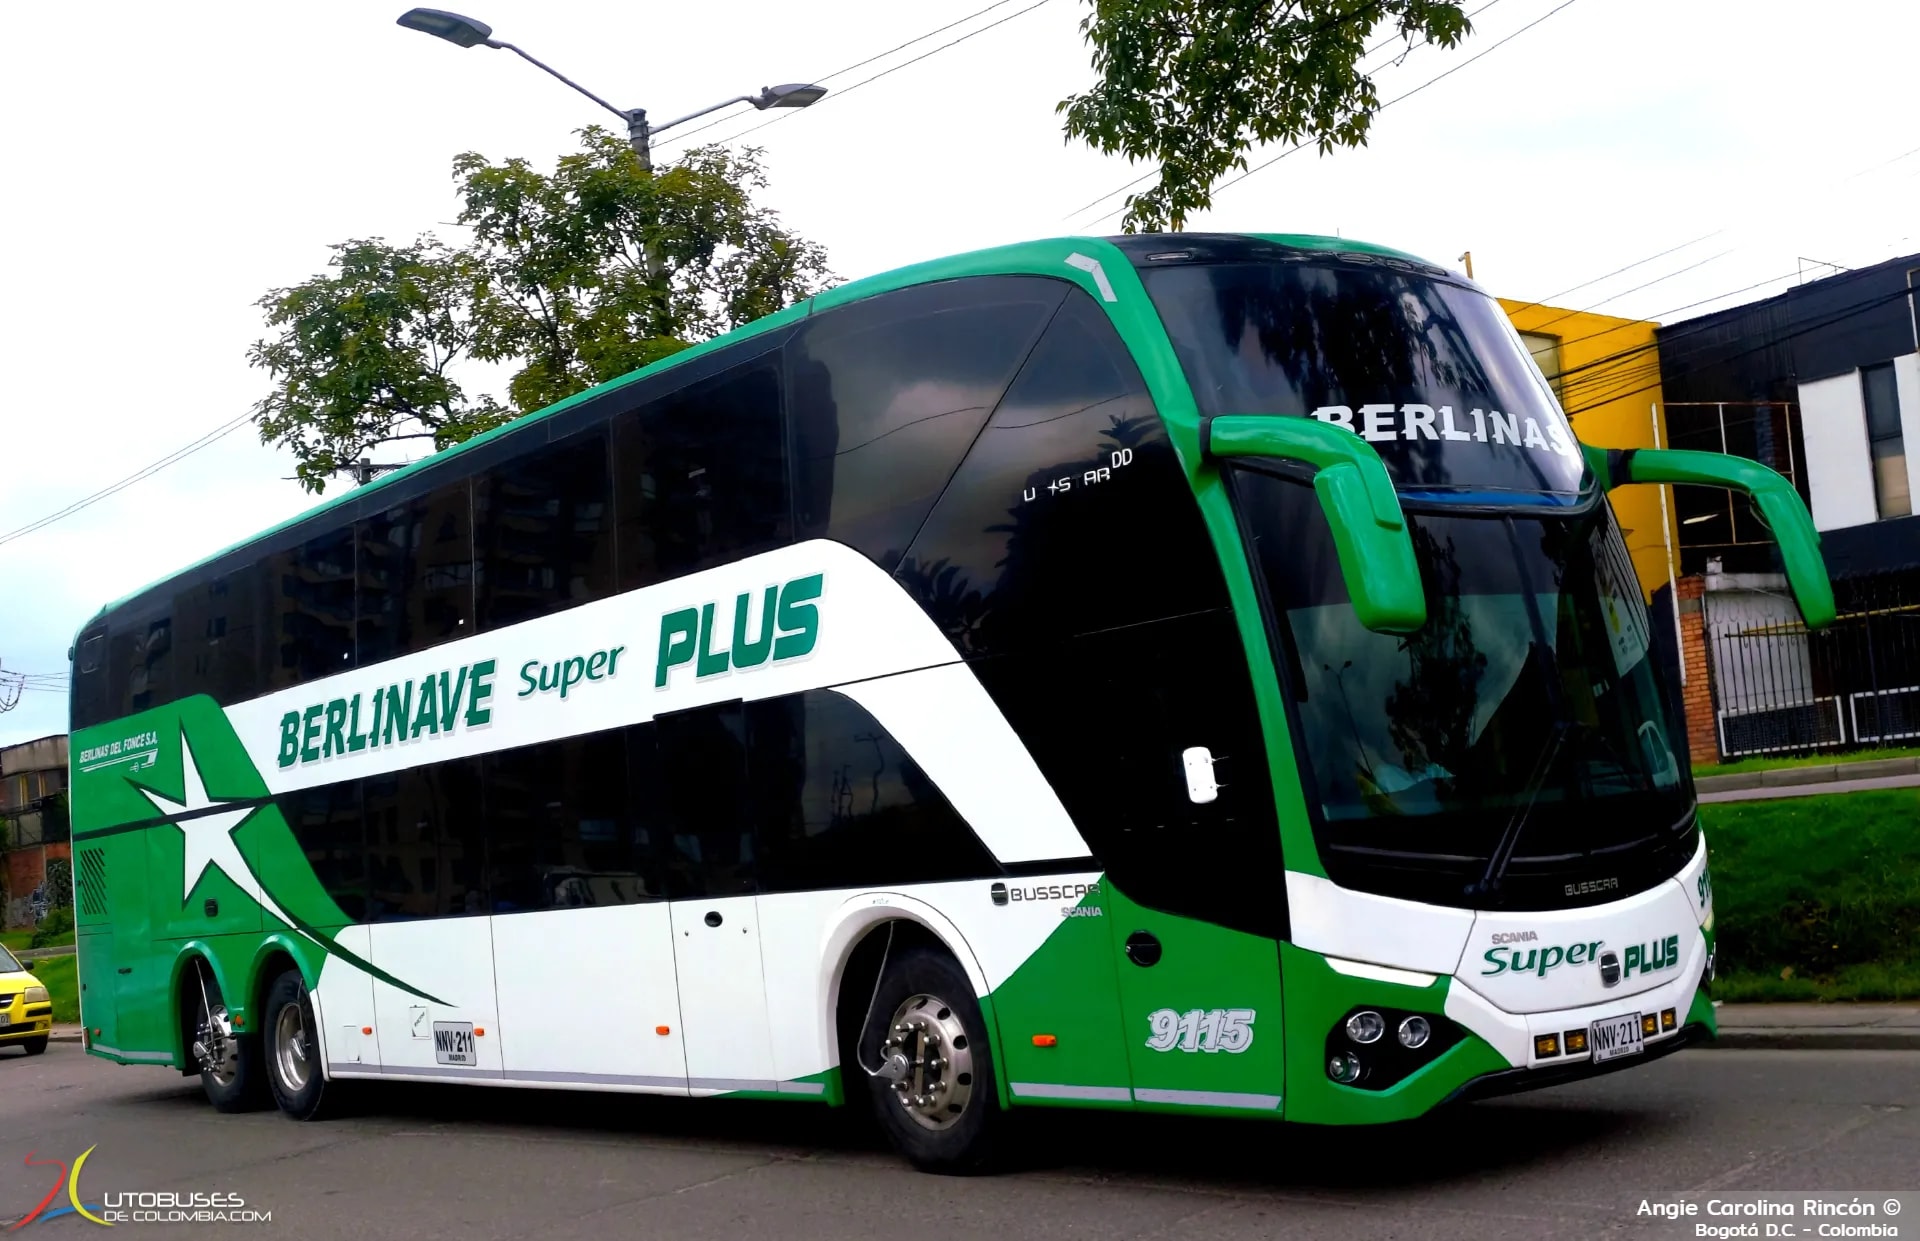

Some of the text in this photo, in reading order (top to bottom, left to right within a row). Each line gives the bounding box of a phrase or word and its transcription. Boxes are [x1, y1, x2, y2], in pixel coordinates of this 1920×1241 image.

[1310, 403, 1573, 457] BERLINAS
[277, 573, 824, 770] BERLINAVE Super PLUS
[79, 744, 109, 763] BERLINAS
[110, 741, 122, 755] DEL
[123, 733, 145, 751] FONCE
[1010, 883, 1100, 902] BUSSCAR
[1565, 877, 1618, 896] BUSSCAR
[1061, 906, 1102, 918] SCANIA
[1492, 930, 1538, 945] SCANIA
[1481, 934, 1679, 978] Super PLUS
[1144, 1008, 1256, 1053] 9115
